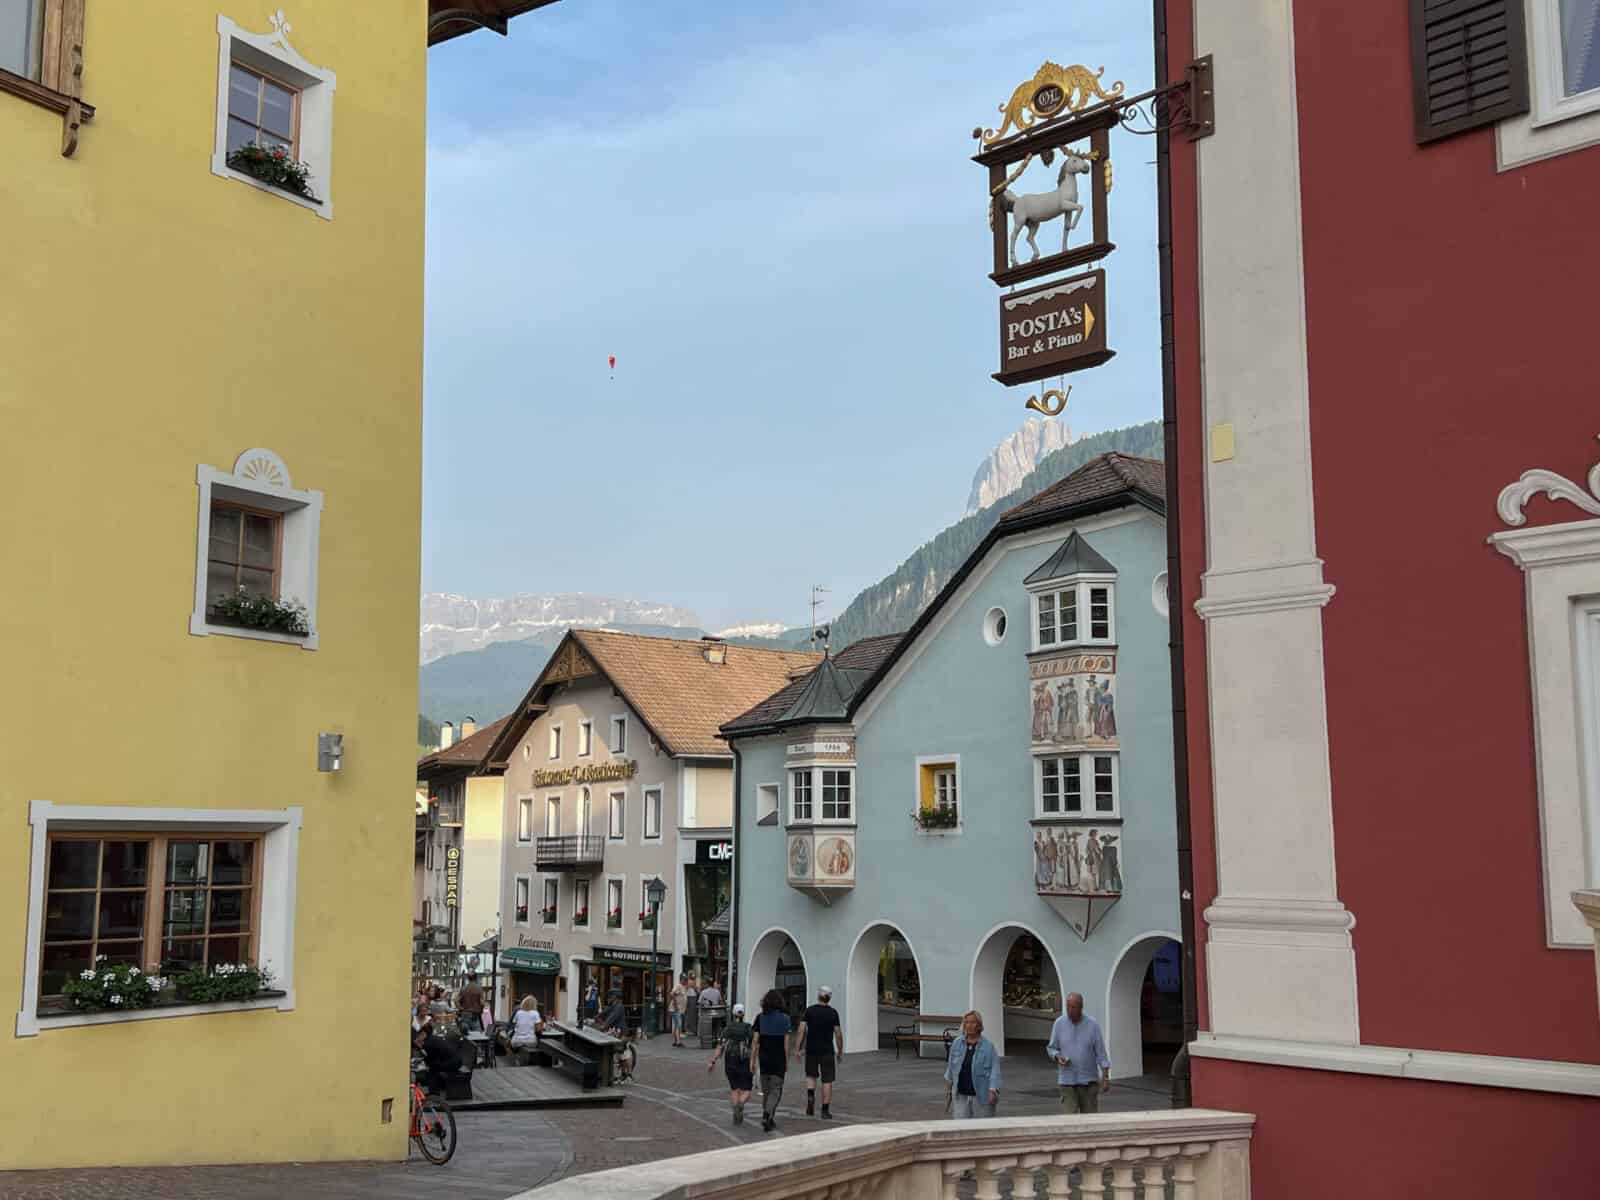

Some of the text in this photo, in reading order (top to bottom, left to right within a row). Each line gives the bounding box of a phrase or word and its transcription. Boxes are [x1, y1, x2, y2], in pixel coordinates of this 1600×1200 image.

[1007, 307, 1082, 341] POSTA's
[1007, 333, 1083, 360] Bar & Piano
